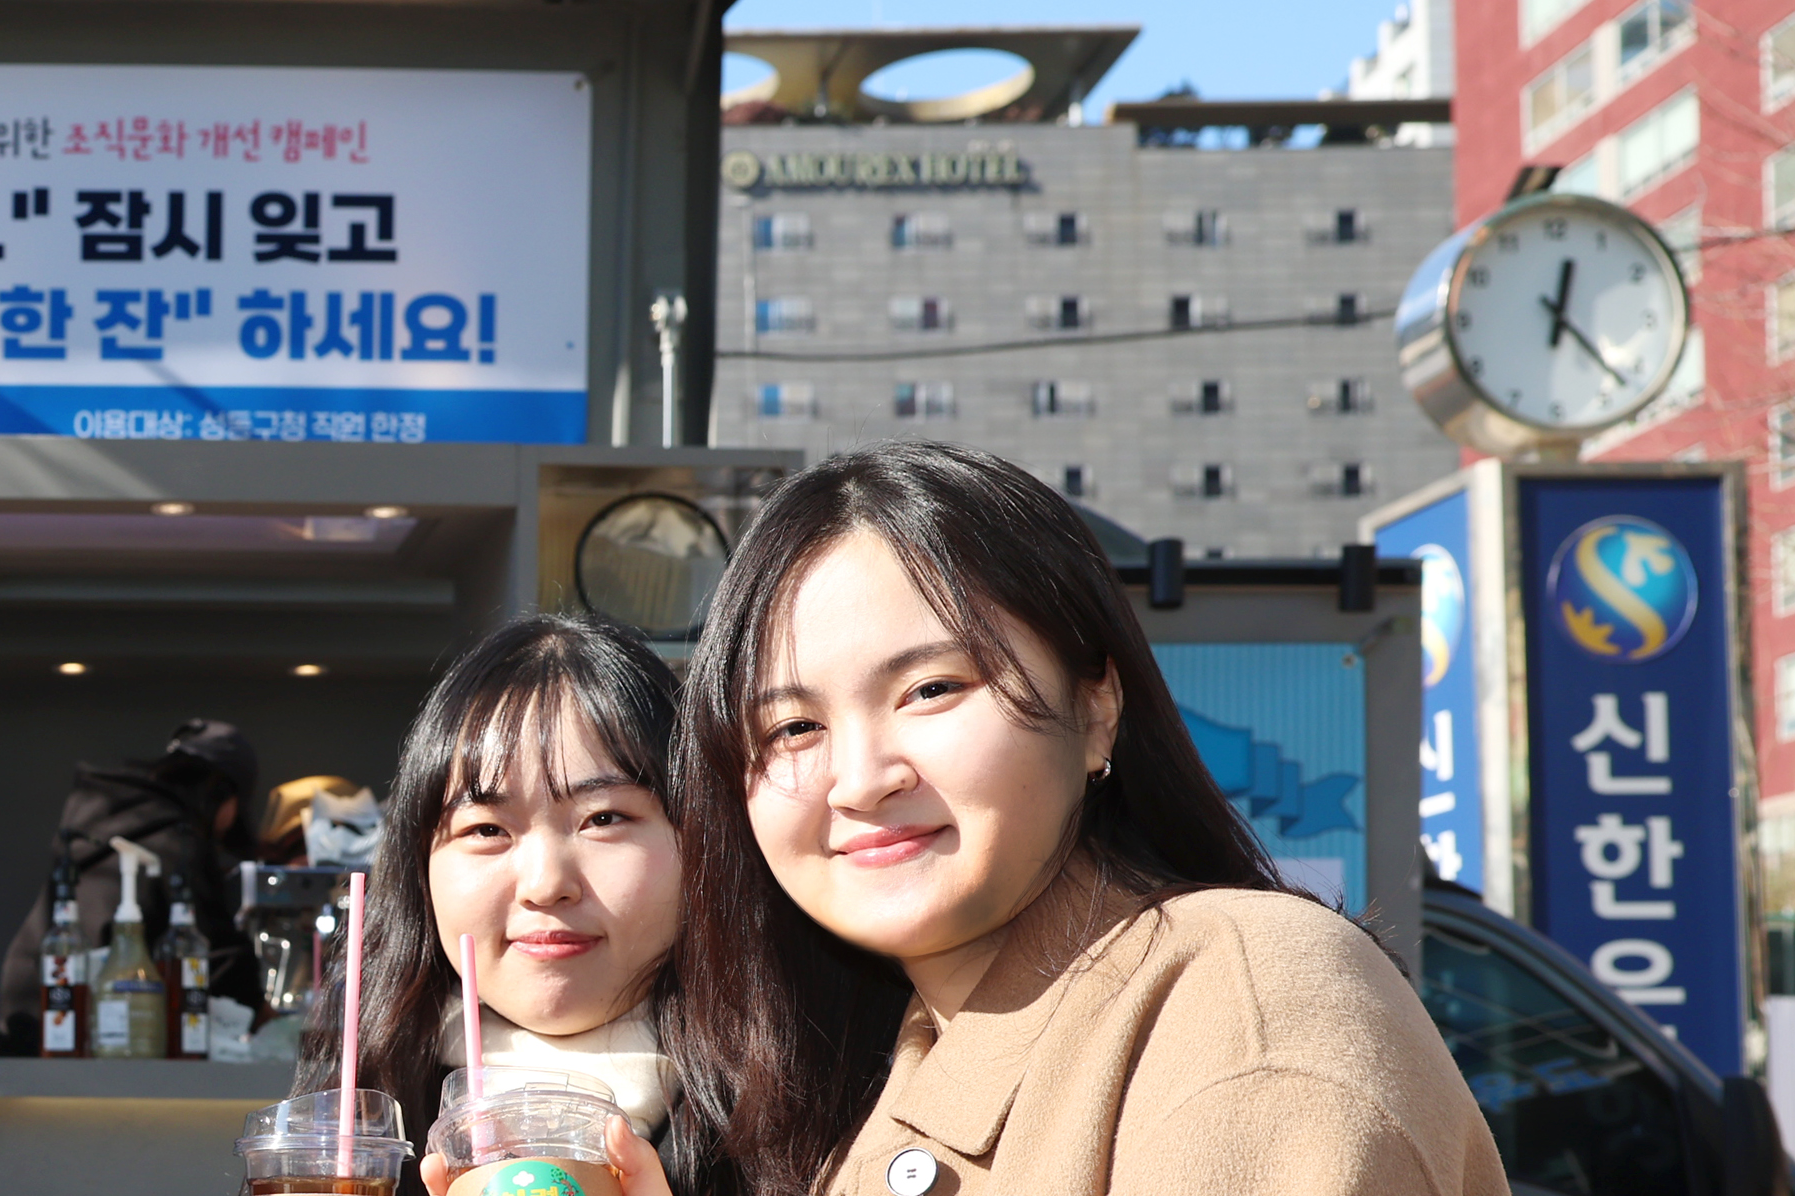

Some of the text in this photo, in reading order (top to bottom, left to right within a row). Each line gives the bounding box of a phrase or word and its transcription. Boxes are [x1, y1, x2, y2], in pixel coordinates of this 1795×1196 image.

[62, 115, 189, 162] 조직문화
[198, 118, 260, 163] 개선
[270, 119, 370, 164] 캠페인
[919, 149, 1021, 184] HOTEL
[73, 189, 224, 262] 잠시
[249, 191, 398, 263] 잊고
[1542, 216, 1569, 240] 12
[93, 287, 213, 361] 잔"
[237, 288, 497, 364] 하세요!
[73, 409, 193, 441] 이용대상:
[311, 411, 367, 443] 직원
[370, 412, 428, 445] 한정
